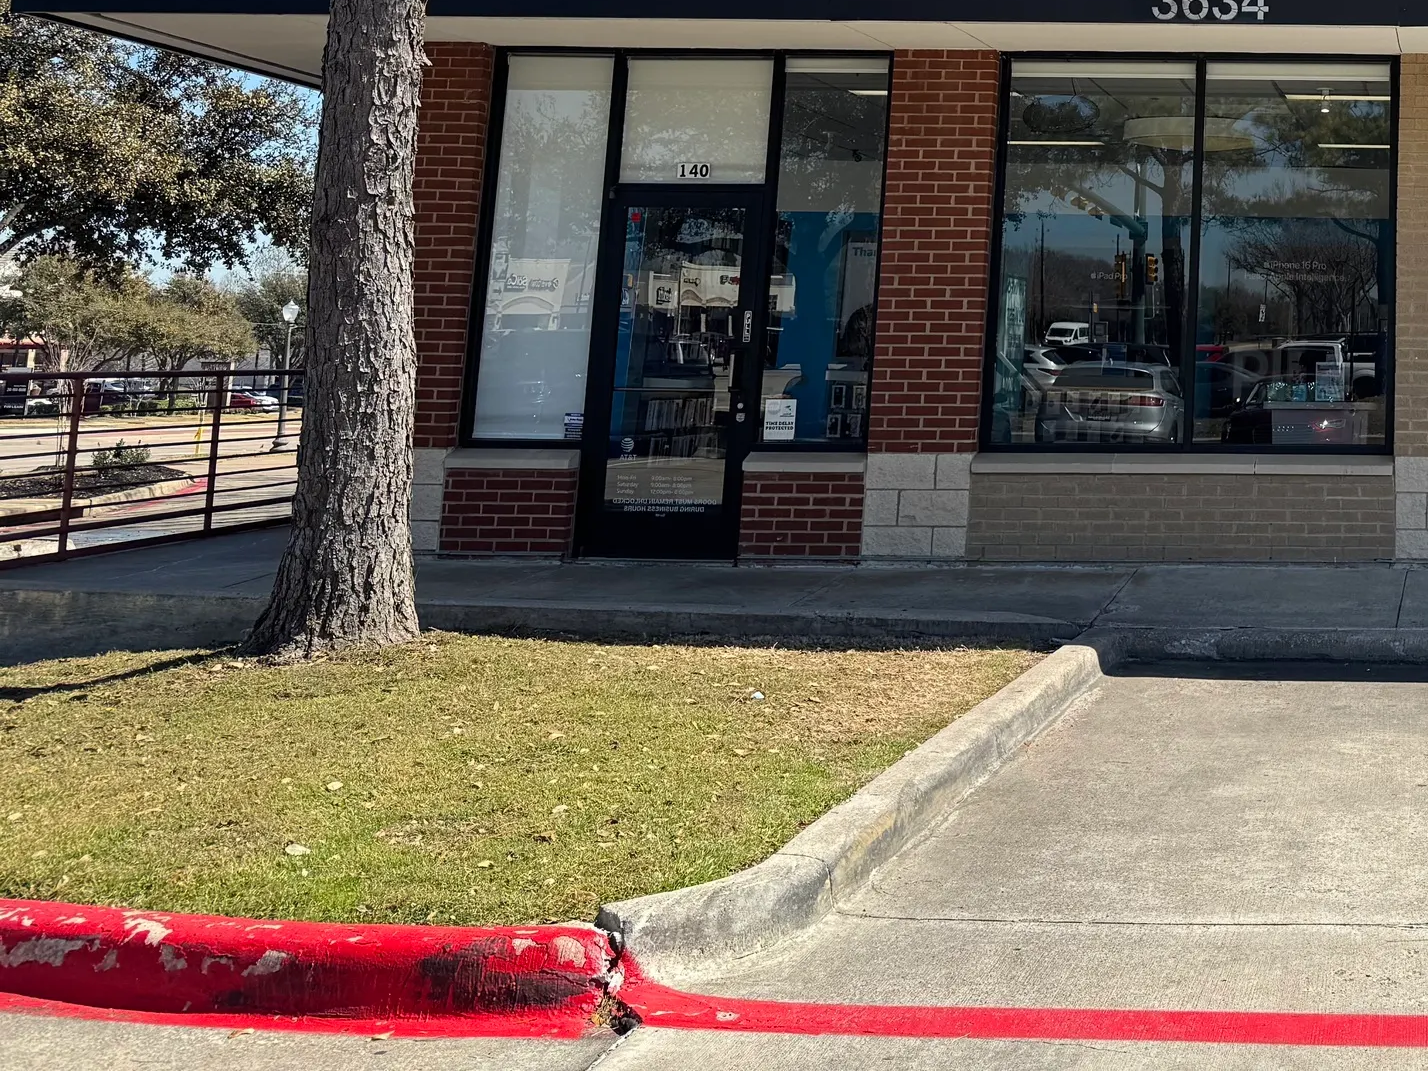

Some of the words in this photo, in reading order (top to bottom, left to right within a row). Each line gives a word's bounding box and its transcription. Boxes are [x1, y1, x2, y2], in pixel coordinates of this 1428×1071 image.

[679, 164, 709, 177] 140
[1270, 260, 1301, 270] iPhone
[1301, 261, 1311, 270] 16
[1311, 261, 1327, 270] Pro
[616, 481, 639, 489] Saturday
